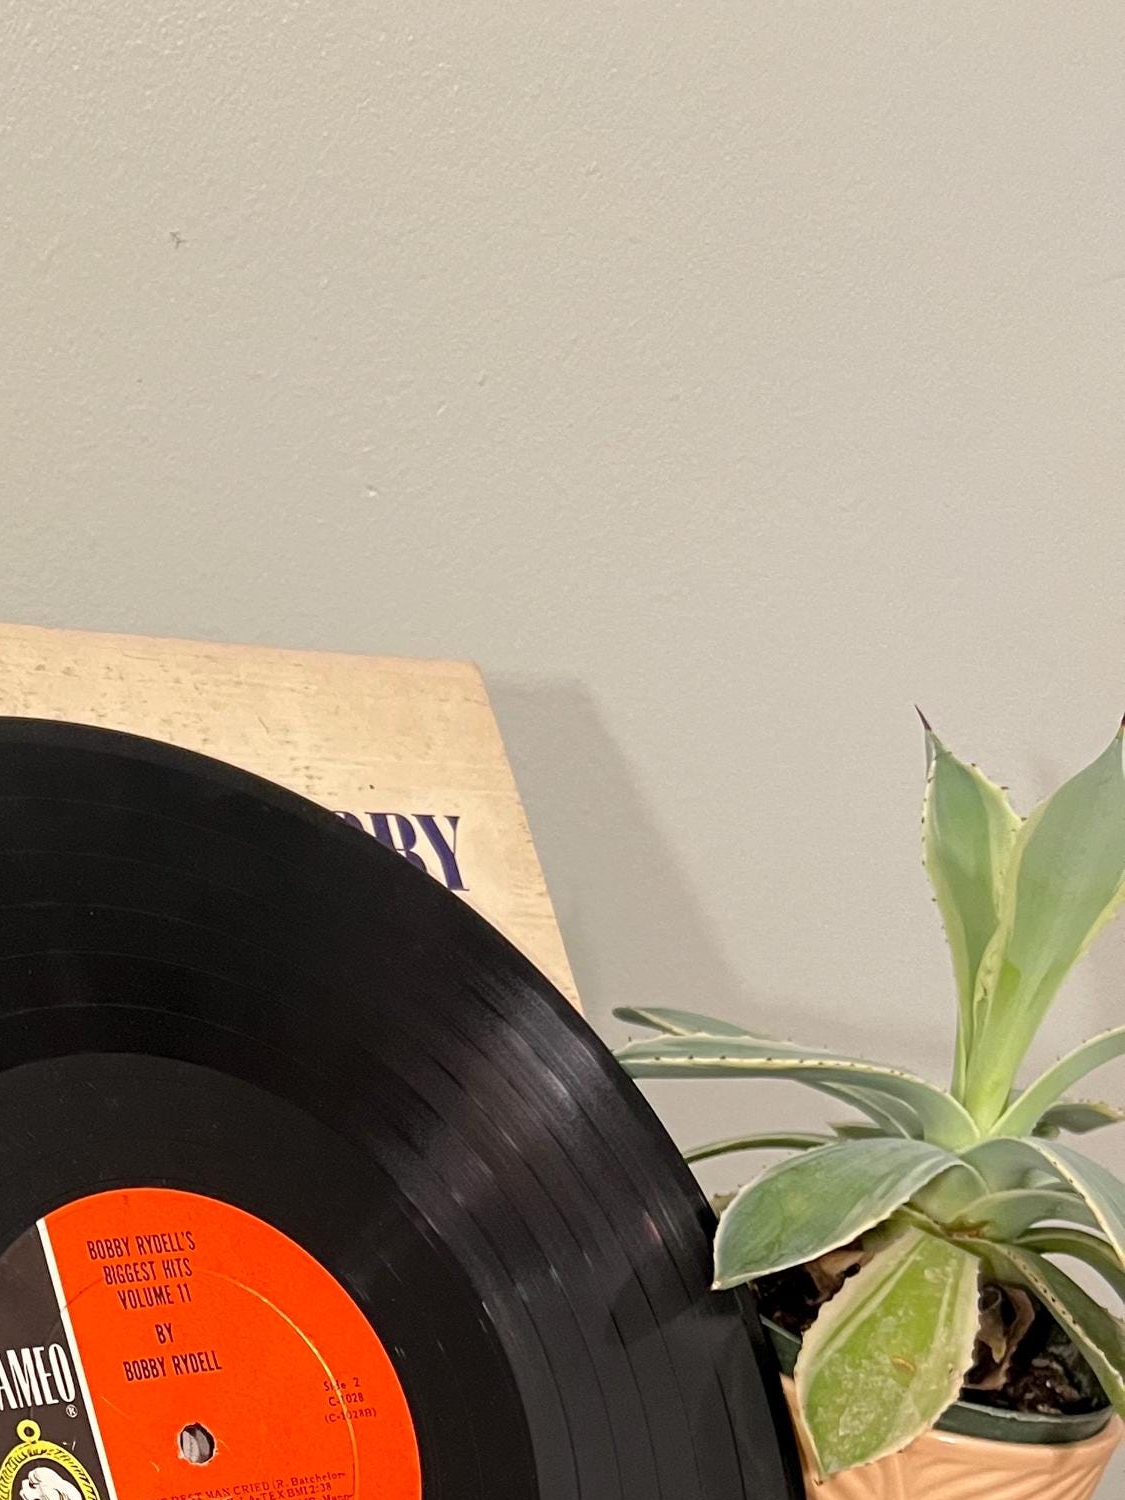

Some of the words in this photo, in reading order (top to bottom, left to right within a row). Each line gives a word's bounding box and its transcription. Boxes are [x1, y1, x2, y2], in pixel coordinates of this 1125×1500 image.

[87, 1237, 131, 1260] BOBBY
[136, 1231, 196, 1256] RYDELL'S
[103, 1261, 158, 1285] BIGGEST
[162, 1258, 193, 1278] HITS
[117, 1286, 174, 1310] VOLUME
[155, 1323, 174, 1344] BY
[123, 1360, 167, 1382] BOBBY
[171, 1350, 223, 1376] RYDELL
[353, 1377, 360, 1387] 2
[206, 1488, 230, 1499] MAN
[233, 1482, 269, 1496] CRIED
